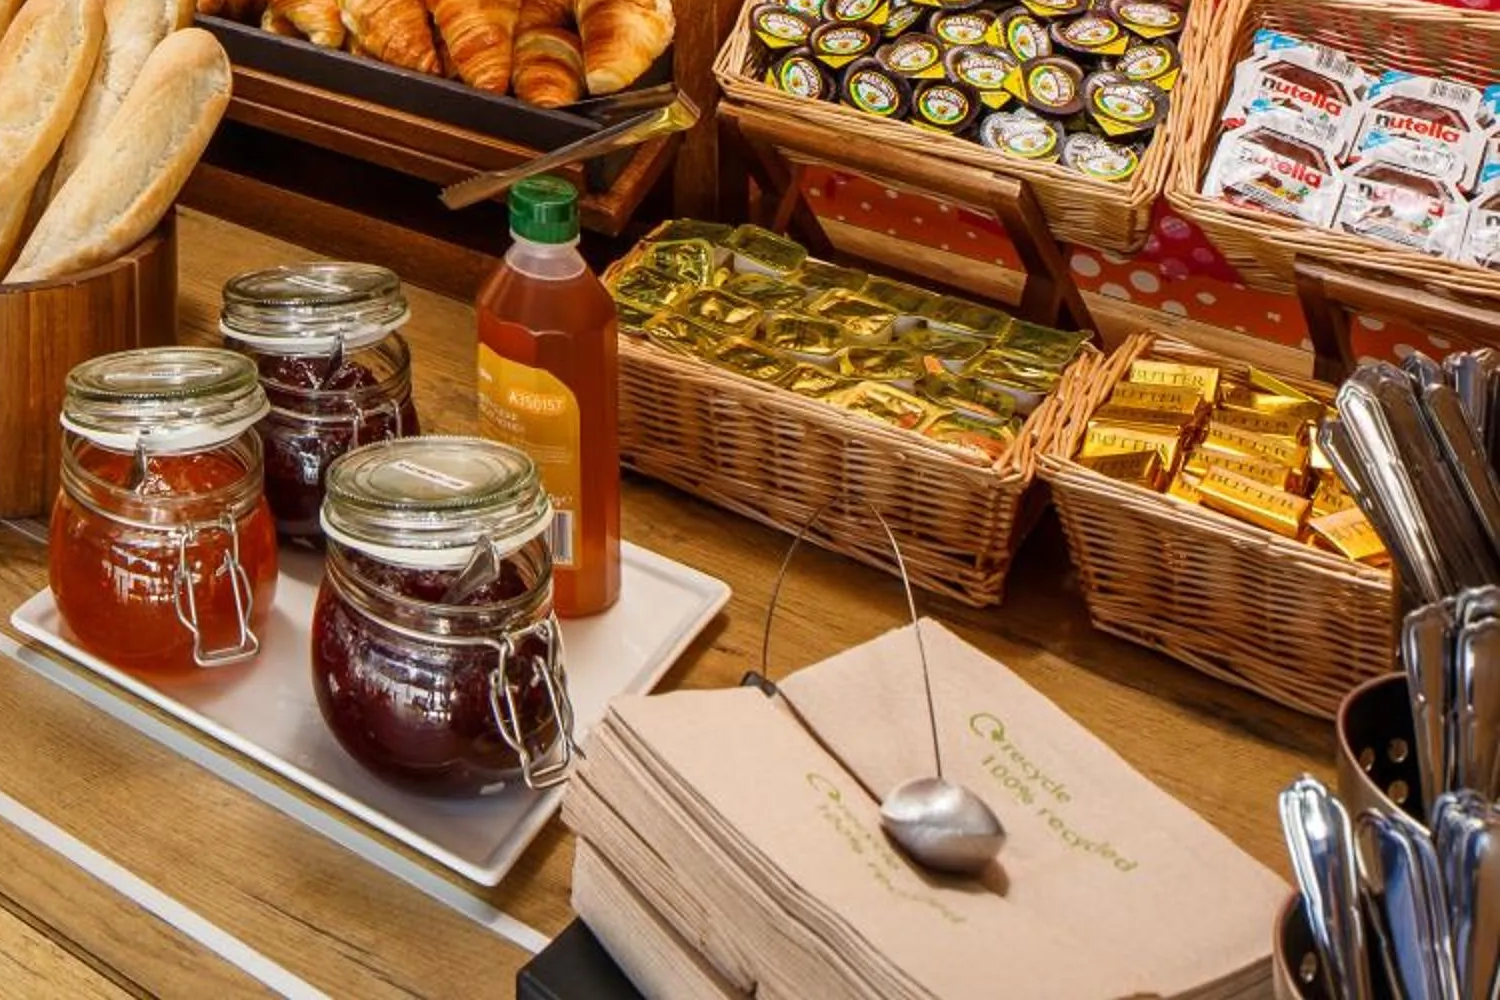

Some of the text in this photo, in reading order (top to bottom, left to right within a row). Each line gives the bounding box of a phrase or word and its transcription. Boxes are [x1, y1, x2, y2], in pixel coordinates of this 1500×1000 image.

[1261, 76, 1343, 117] nutella
[1375, 113, 1460, 143] nutella
[1209, 470, 1296, 509] BUTTER
[1002, 743, 1072, 803] recycle
